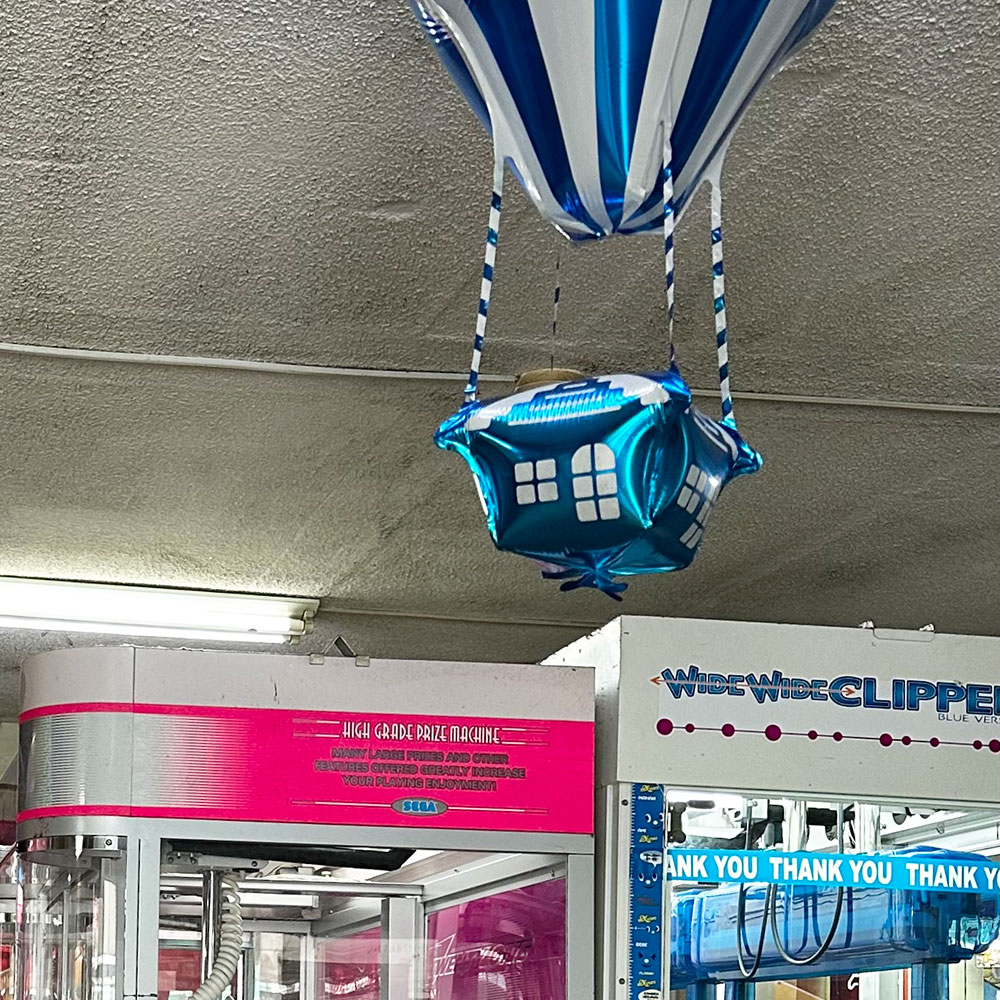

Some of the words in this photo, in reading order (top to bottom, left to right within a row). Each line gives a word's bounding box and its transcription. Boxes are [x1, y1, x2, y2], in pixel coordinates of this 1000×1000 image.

[829, 676, 1000, 716] CLIPPE
[938, 713, 969, 723] BLUE
[342, 721, 371, 739] HIGH
[374, 722, 413, 741] GRADE
[416, 724, 448, 742] PRIZE
[449, 725, 500, 744] MACHINE
[332, 747, 367, 758] MANY
[369, 748, 404, 760] LARGE
[406, 750, 444, 762] PRIZES
[445, 752, 470, 762] AND
[472, 753, 509, 764] OTHER
[314, 760, 368, 772] FEATURES
[371, 762, 418, 774] OFFERED
[420, 765, 471, 776] GREATLY
[472, 767, 526, 778] INCREASE
[342, 775, 373, 786] YOUR
[375, 777, 424, 788] PLAYING
[425, 779, 497, 791] ENJOYMENT!
[402, 800, 437, 813] SEGA
[716, 856, 758, 879] YOU
[769, 857, 843, 882] THANK
[848, 860, 892, 884] YOU
[905, 863, 978, 889] THANK
